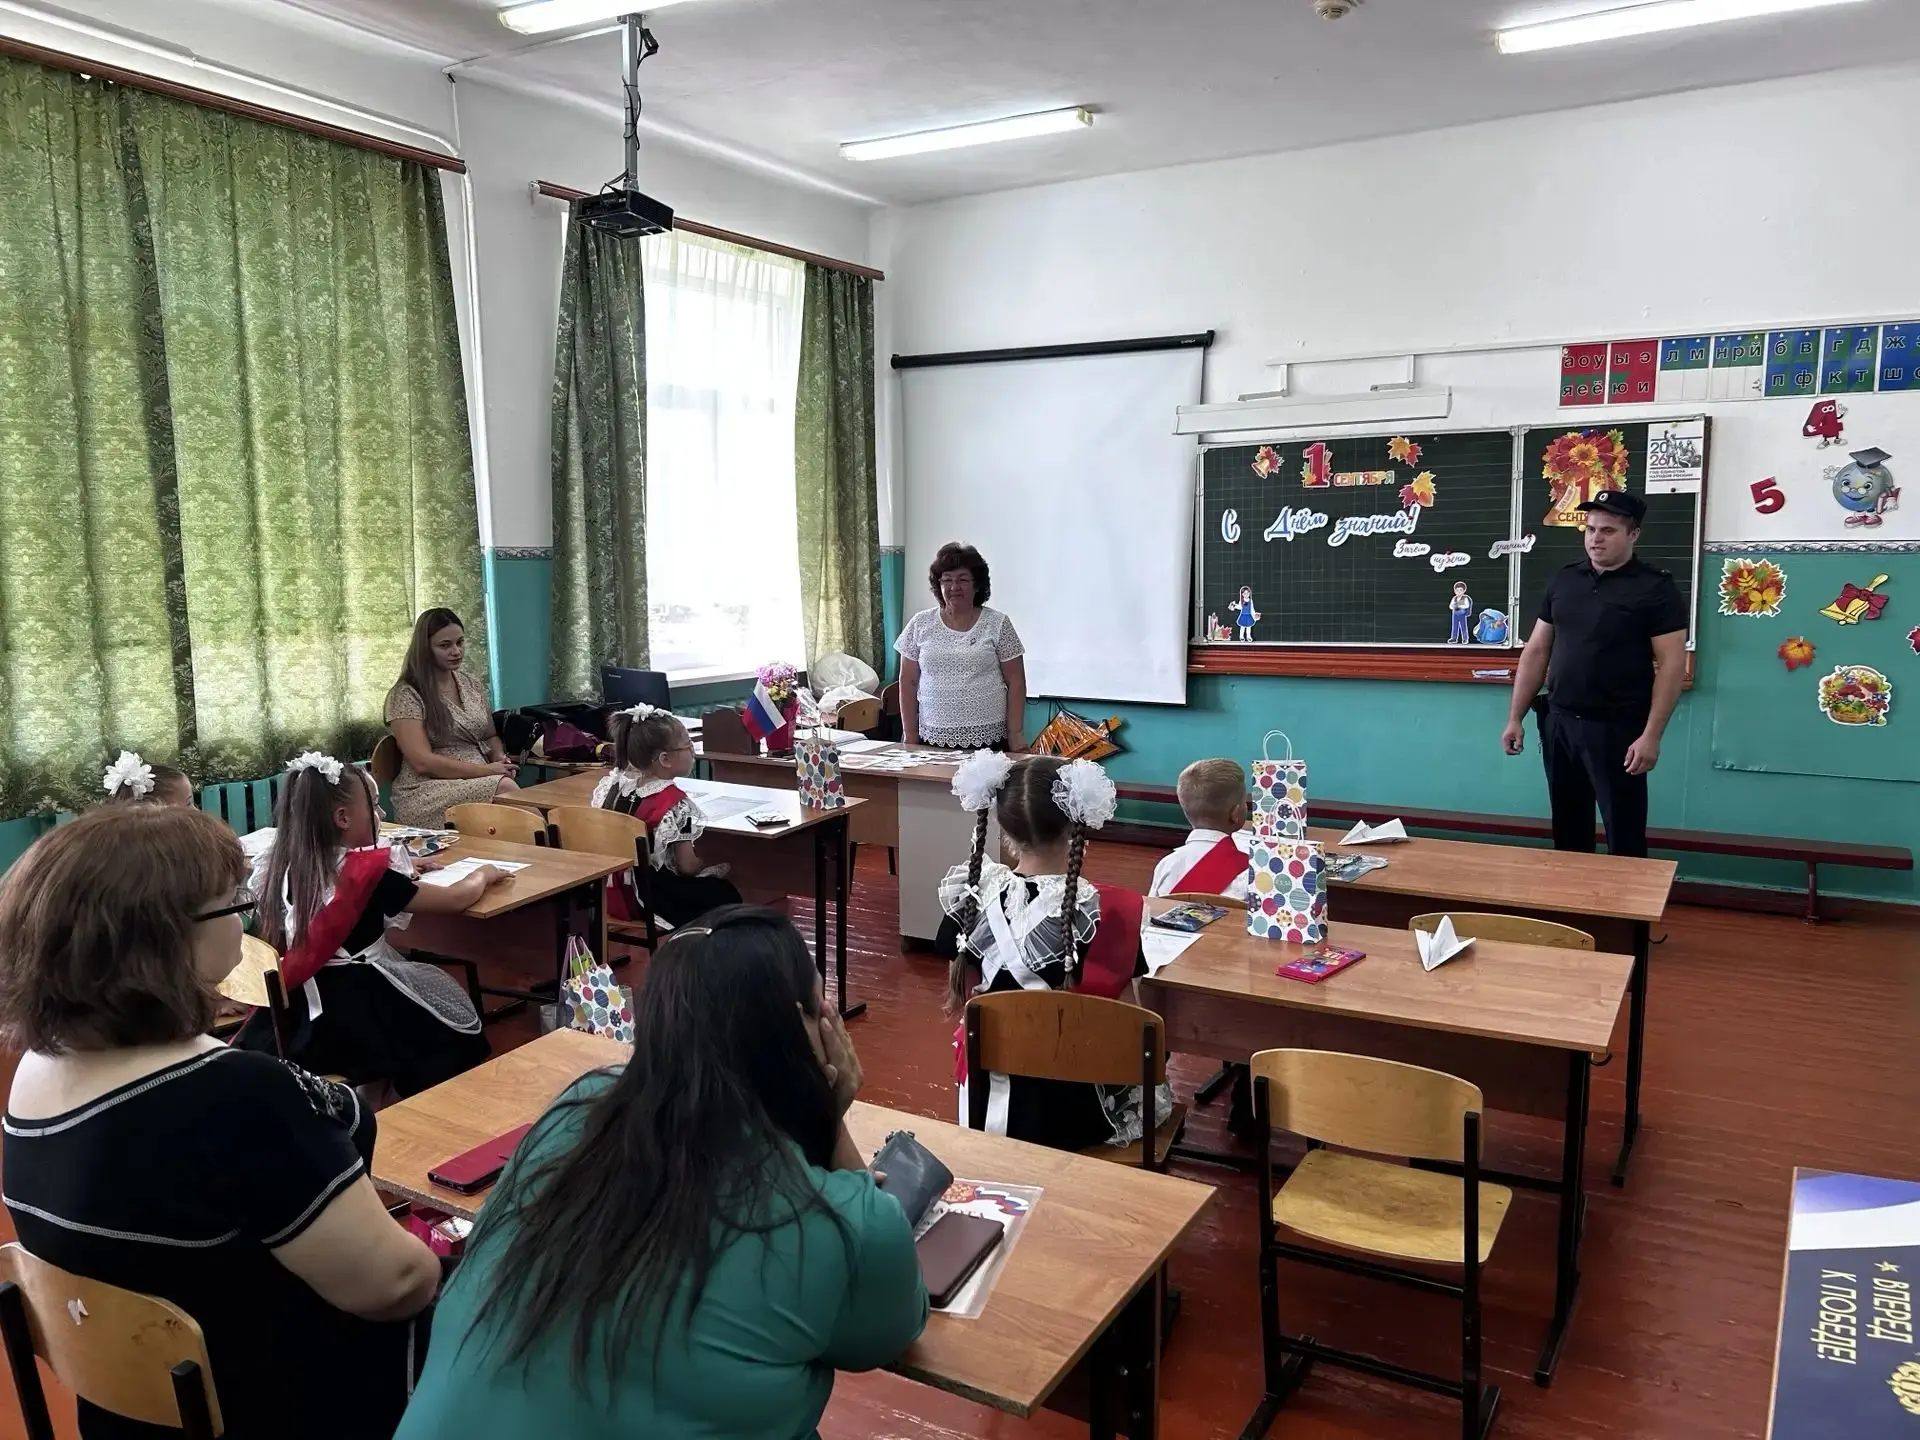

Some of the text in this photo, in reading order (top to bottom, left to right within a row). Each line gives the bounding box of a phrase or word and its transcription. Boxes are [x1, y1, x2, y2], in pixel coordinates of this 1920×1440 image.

[1579, 355, 1590, 367] о
[1593, 354, 1605, 368] у
[1615, 353, 1629, 366] ы
[1639, 352, 1651, 364] э
[1666, 349, 1679, 362] л
[1690, 348, 1704, 361] м
[1716, 347, 1728, 360] н
[1732, 346, 1745, 361] р
[1750, 340, 1761, 357] й
[1774, 339, 1787, 356] б
[1801, 341, 1812, 354] в
[1832, 339, 1843, 352] г
[1856, 337, 1871, 353] д
[1885, 336, 1906, 349] ж
[1561, 385, 1573, 397] я
[1577, 383, 1589, 396] е
[1592, 380, 1603, 395] ё
[1612, 382, 1628, 395] ю
[1637, 381, 1650, 394] и
[1772, 373, 1785, 386] п
[1795, 369, 1813, 388] ф
[1828, 371, 1842, 384] к
[1855, 369, 1868, 383] т
[1883, 367, 1903, 381] ш
[1304, 443, 1395, 488] 1 СЕНТЯБРЯ
[1649, 441, 1668, 454] 20
[1749, 476, 1785, 515] 5
[1266, 507, 1326, 539] Днём
[1331, 505, 1419, 545] знаний!
[1557, 512, 1589, 522] СЕНТЯ
[1810, 1268, 1858, 1365] К ПОБЕДЕ!
[1864, 1277, 1914, 1344] ВПЕРЕД
